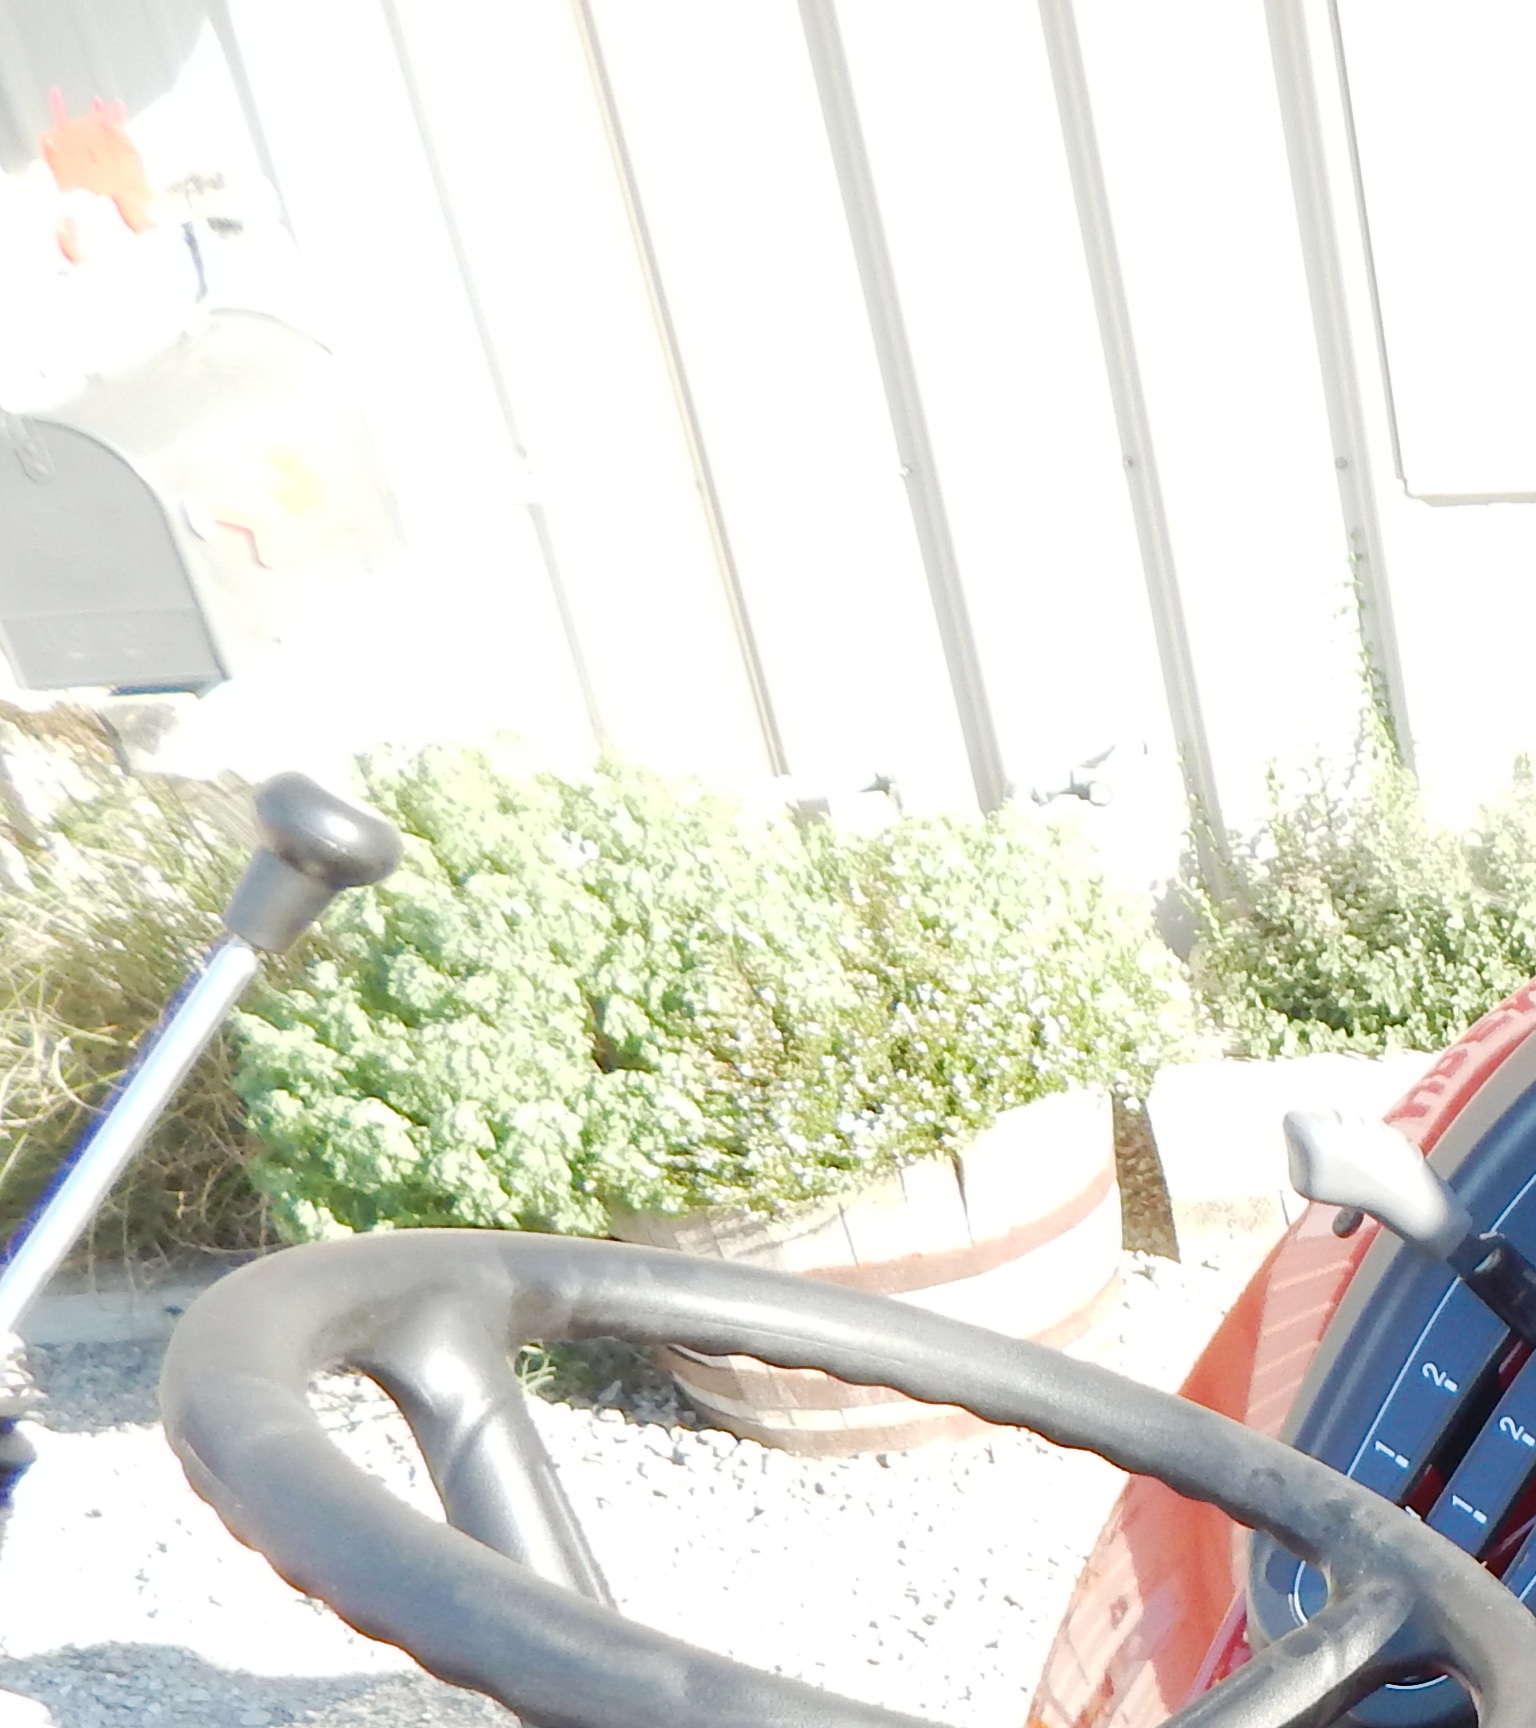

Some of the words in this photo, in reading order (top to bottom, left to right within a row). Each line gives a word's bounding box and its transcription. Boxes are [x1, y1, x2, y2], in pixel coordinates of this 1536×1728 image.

[1422, 1363, 1447, 1387] 2
[1499, 1416, 1525, 1441] 2
[1375, 1440, 1396, 1458] 1
[1452, 1495, 1473, 1513] 1
